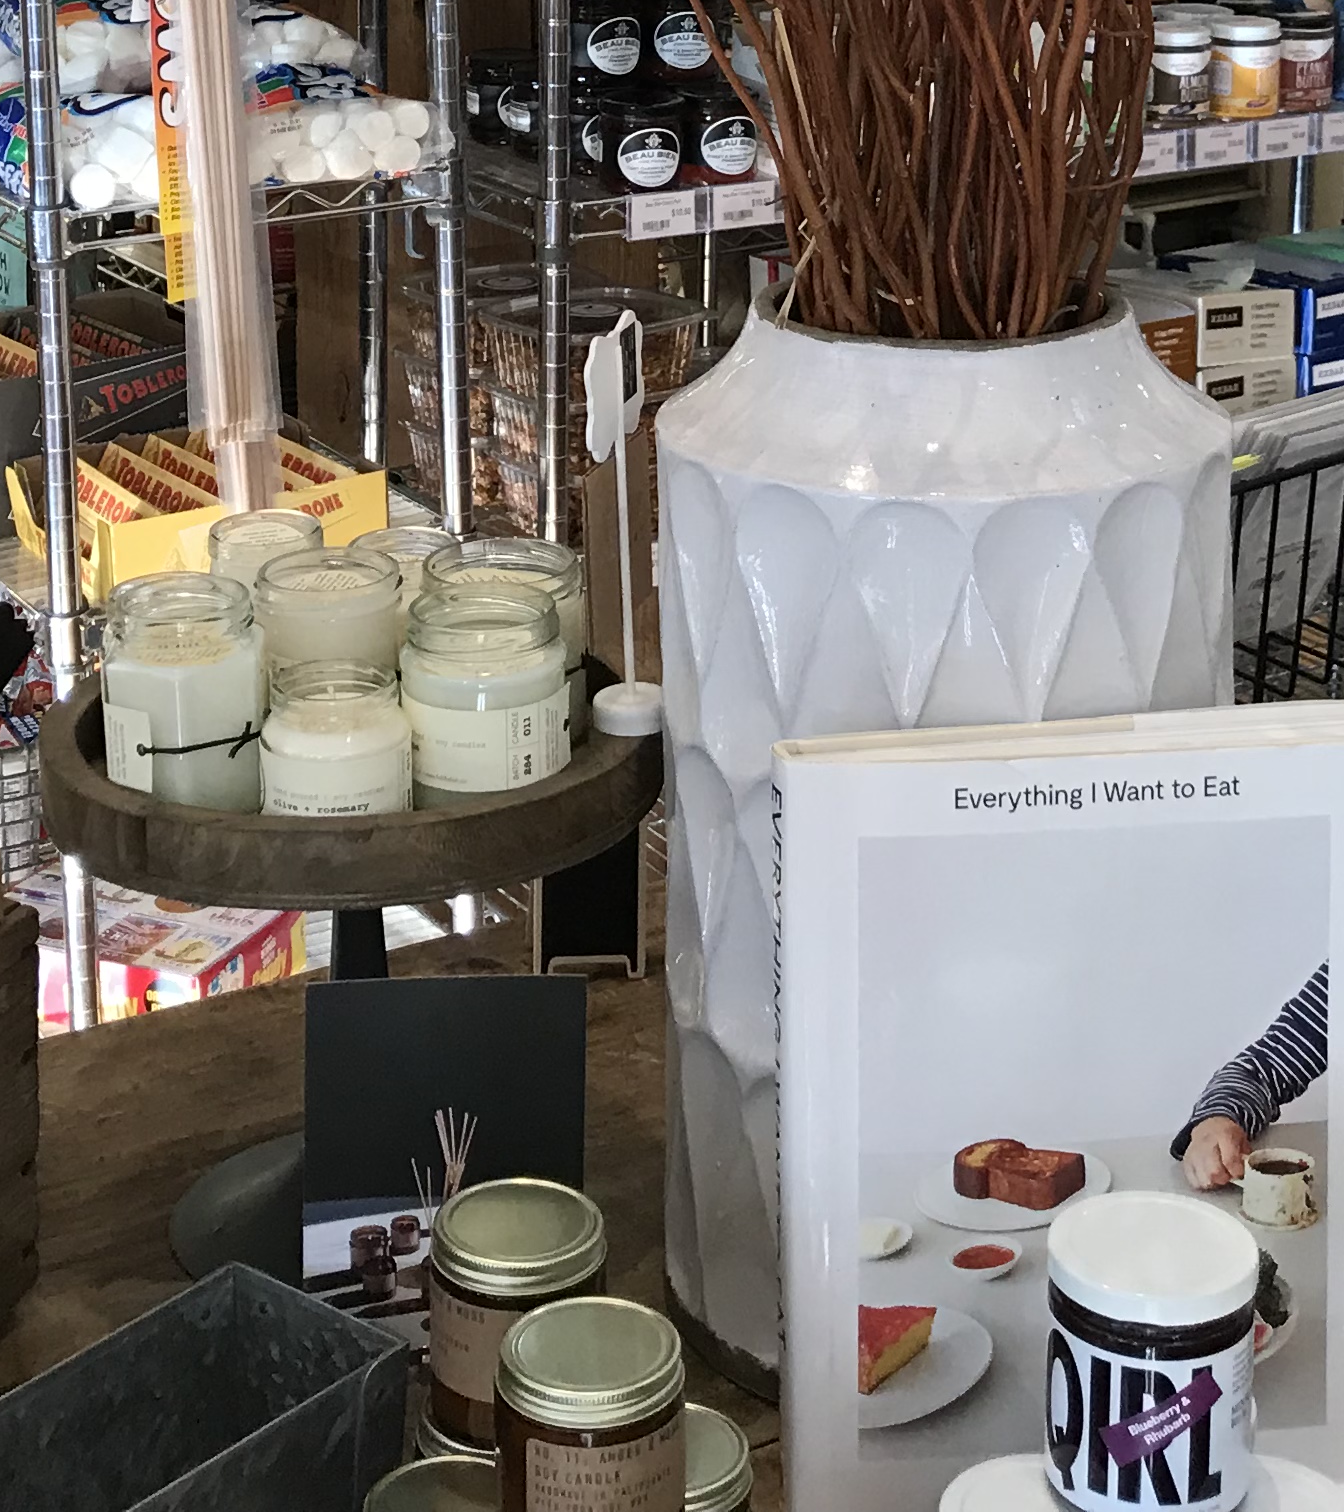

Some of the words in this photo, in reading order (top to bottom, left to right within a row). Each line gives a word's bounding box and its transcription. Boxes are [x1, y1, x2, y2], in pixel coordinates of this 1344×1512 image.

[594, 39, 623, 53] BEAU
[624, 150, 655, 163] BEAU
[708, 139, 738, 152] BEAU
[100, 362, 188, 415] TOBLERO
[511, 711, 520, 745] CANDLE
[523, 716, 532, 737] 011
[511, 753, 520, 781] BATCH
[272, 797, 299, 812] olive
[316, 800, 371, 815] rosemary
[953, 785, 1083, 814] Everything
[1089, 782, 1097, 804] I
[1103, 778, 1167, 803] Want
[1171, 780, 1196, 800] to
[1202, 775, 1241, 798] Eat
[1127, 1404, 1182, 1437] Blueberry
[1181, 1396, 1192, 1407] &
[1143, 1411, 1192, 1446] Rhubarb
